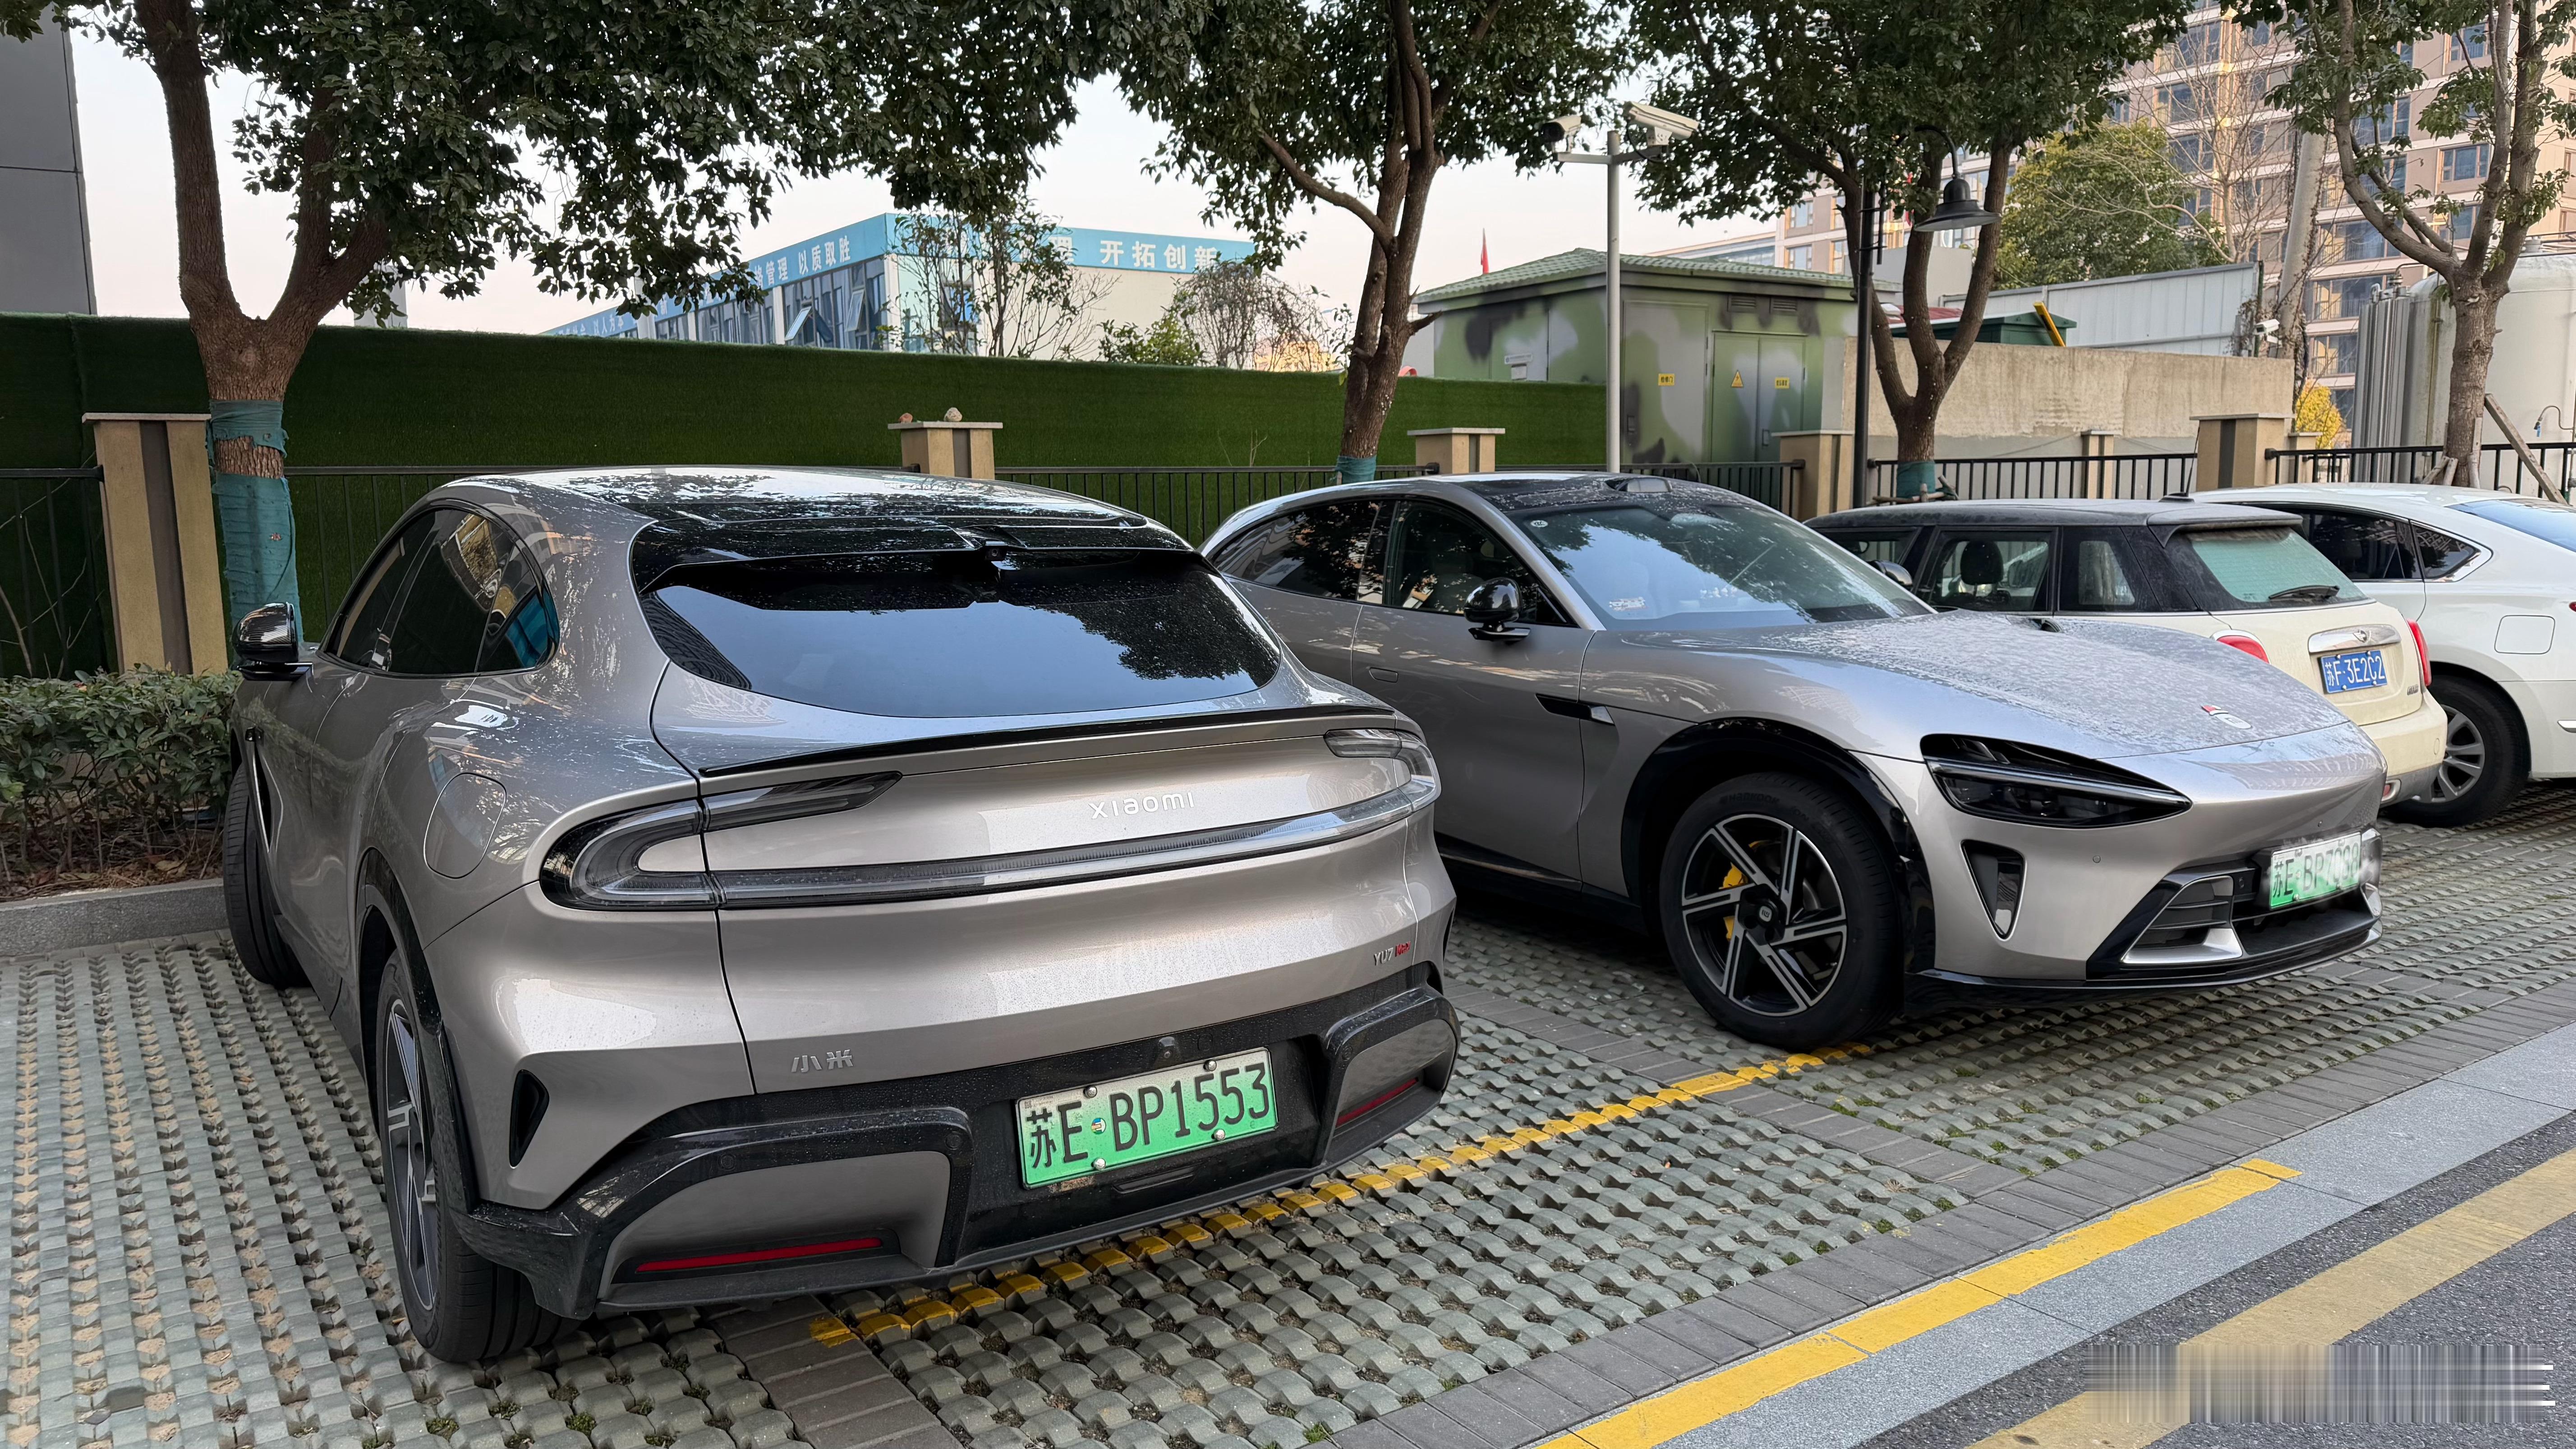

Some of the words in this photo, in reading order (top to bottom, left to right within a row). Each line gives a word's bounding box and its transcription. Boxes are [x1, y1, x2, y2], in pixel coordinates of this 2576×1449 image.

[798, 235, 851, 275] 以质取胜
[1099, 240, 1217, 271] 开拓创新
[1374, 948, 1394, 966] YU7
[791, 1049, 853, 1073] 小米
